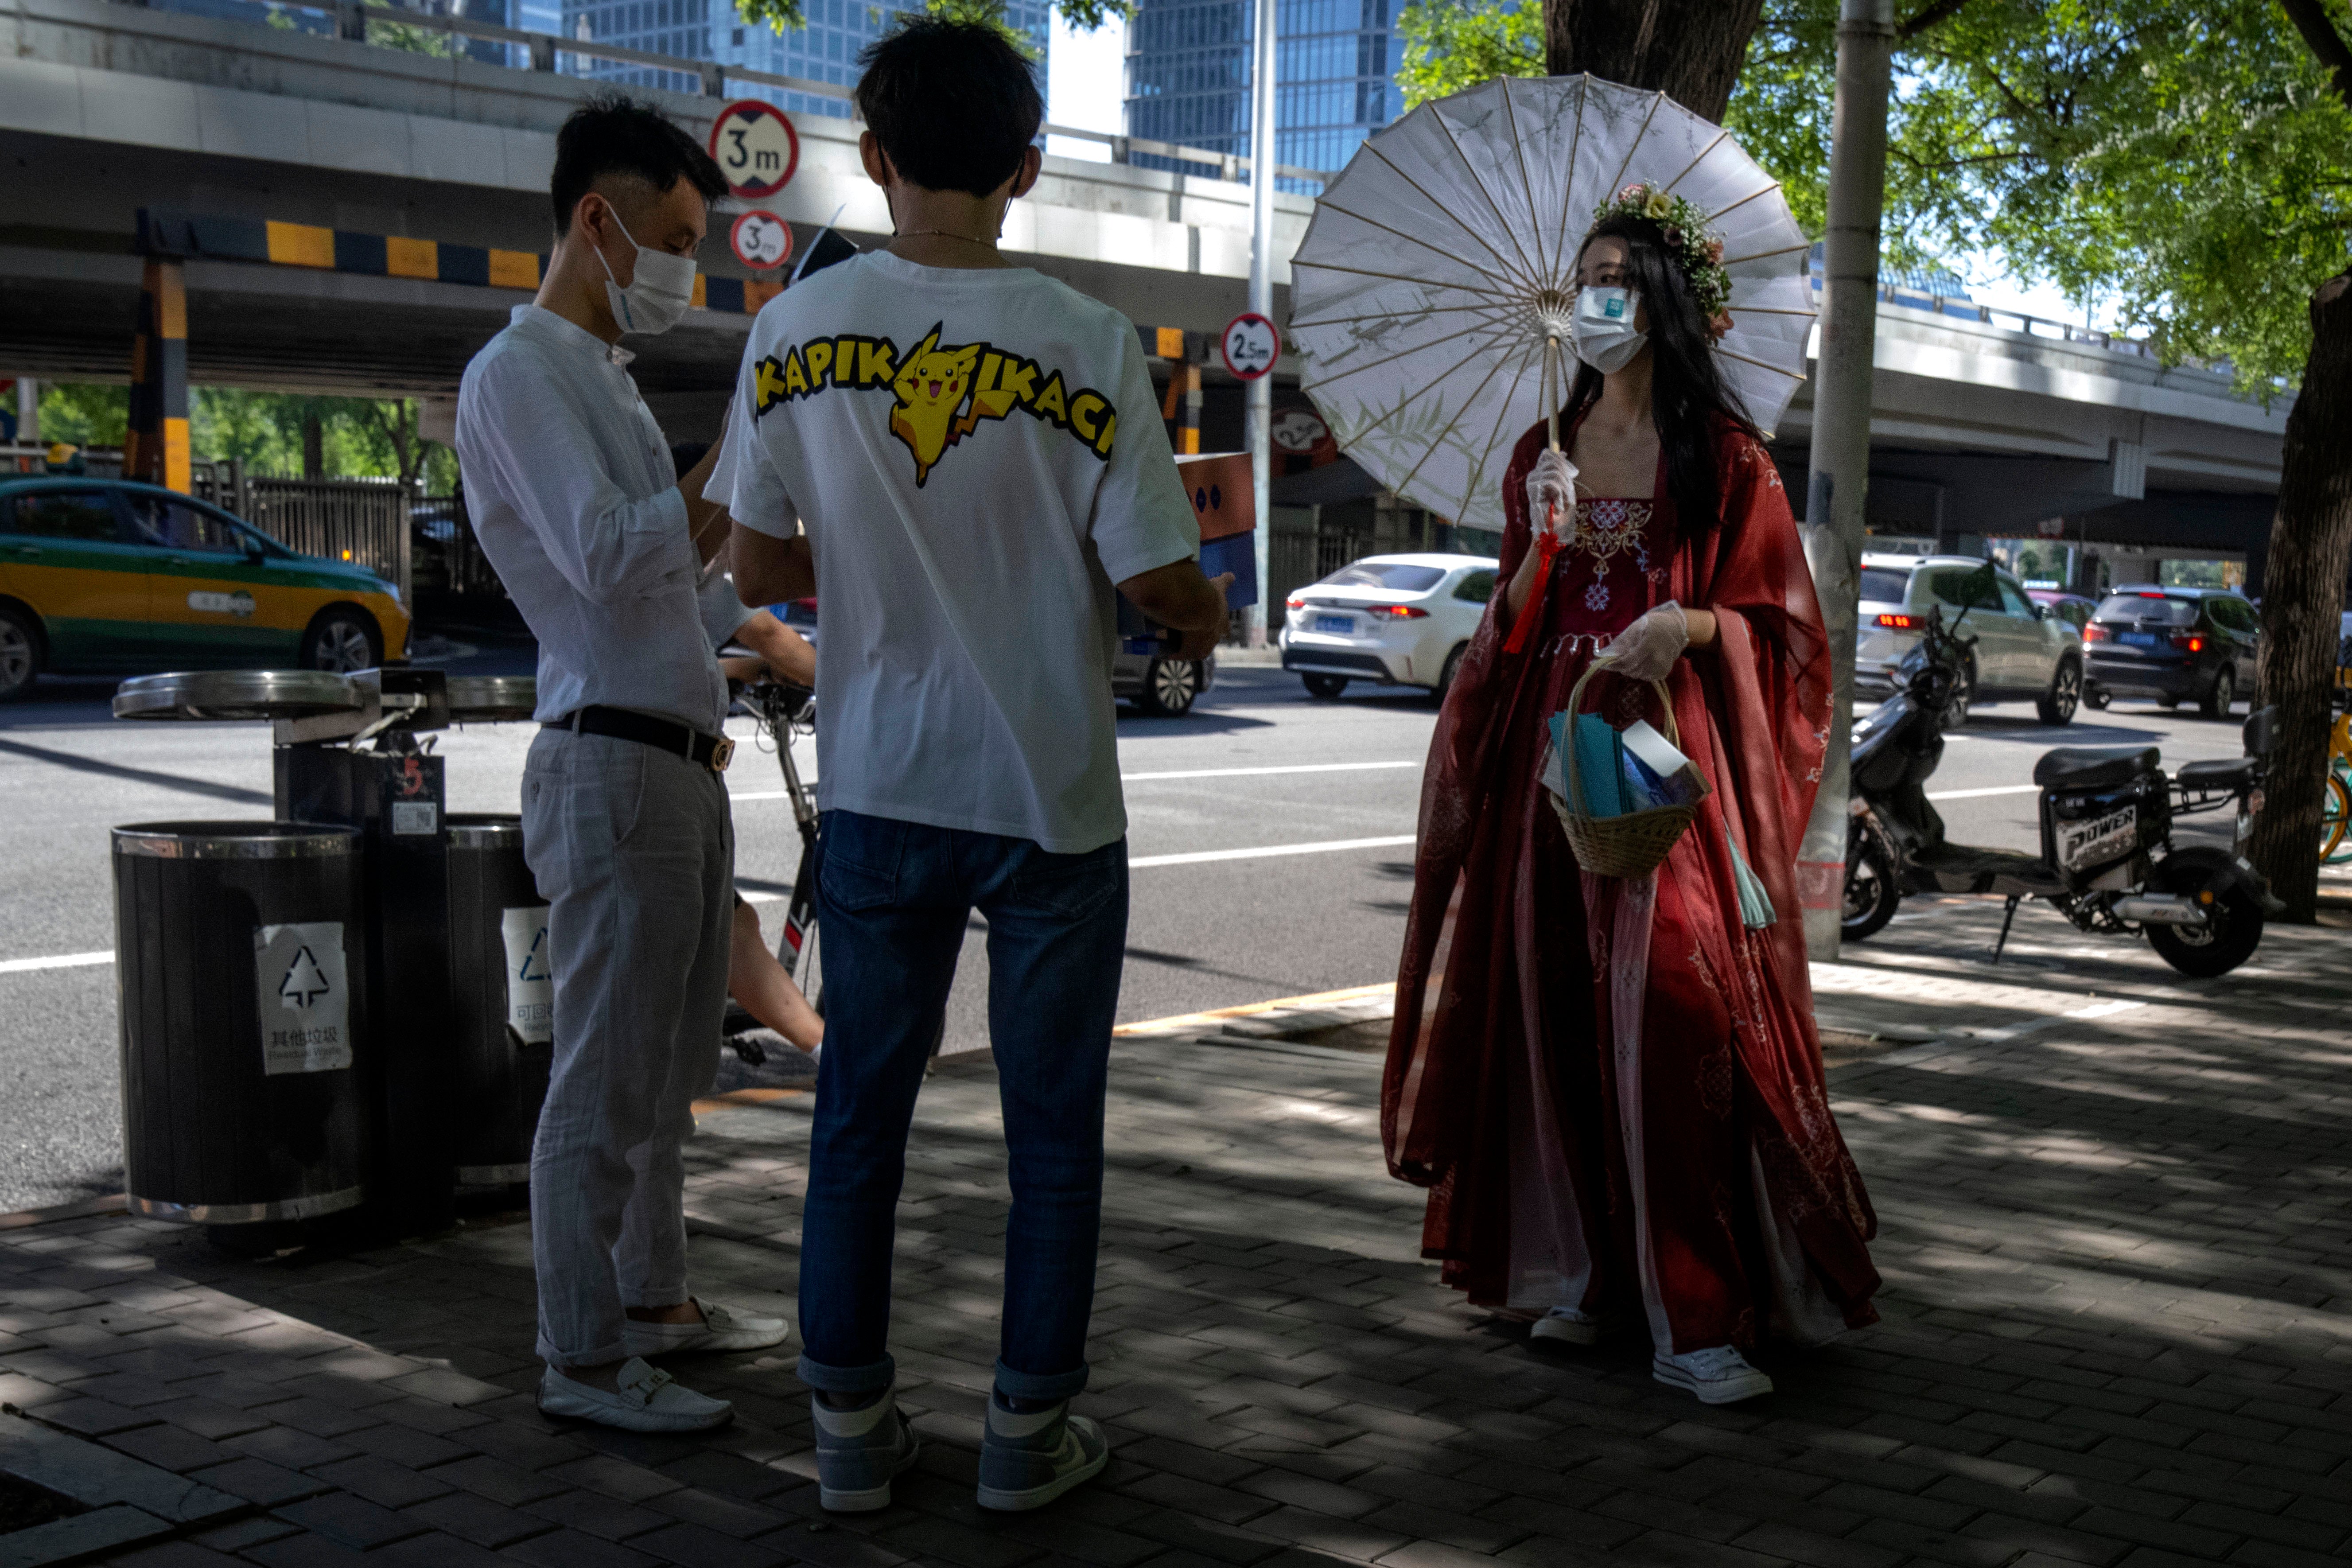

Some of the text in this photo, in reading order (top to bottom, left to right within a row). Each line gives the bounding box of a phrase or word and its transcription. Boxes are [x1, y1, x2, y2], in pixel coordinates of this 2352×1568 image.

[727, 129, 780, 170] 3m
[745, 225, 777, 254] 3m
[2066, 809, 2134, 862] POWER
[271, 1026, 338, 1047] 其他垃圾
